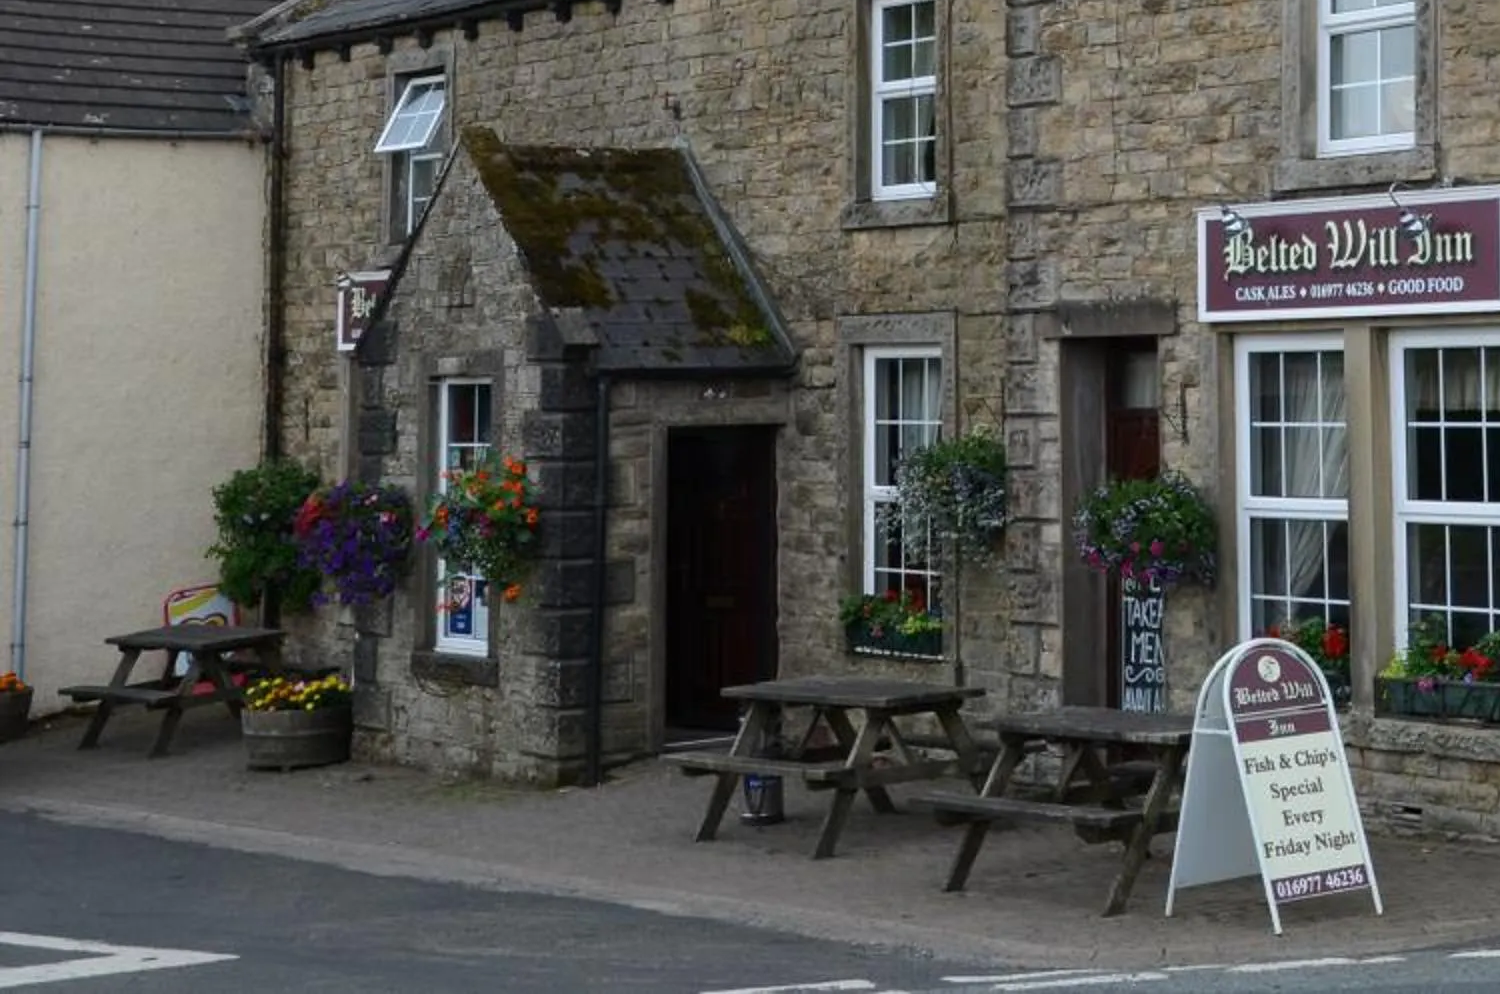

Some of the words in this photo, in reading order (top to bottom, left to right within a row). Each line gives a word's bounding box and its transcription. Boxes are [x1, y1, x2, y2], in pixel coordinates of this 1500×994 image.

[1223, 228, 1318, 281] Belted
[1325, 218, 1399, 268] Will
[1407, 214, 1473, 265] Inn
[1235, 285, 1265, 302] CASK
[1266, 285, 1297, 301] ALES
[1310, 282, 1343, 299] 016977
[1388, 278, 1426, 295] GOOD
[1427, 275, 1465, 293] FOOD
[1233, 686, 1280, 706] Belted
[1282, 682, 1313, 700] Will
[1266, 718, 1296, 736] Inn
[1244, 754, 1275, 775] Fish
[1279, 752, 1292, 770] &
[1295, 748, 1338, 772] Chip's
[1269, 777, 1325, 802] Special
[1281, 808, 1325, 828] Every
[1263, 837, 1312, 859] Friday
[1315, 832, 1357, 852] Night
[1276, 874, 1321, 898] 016977
[1325, 868, 1364, 889] 46236
